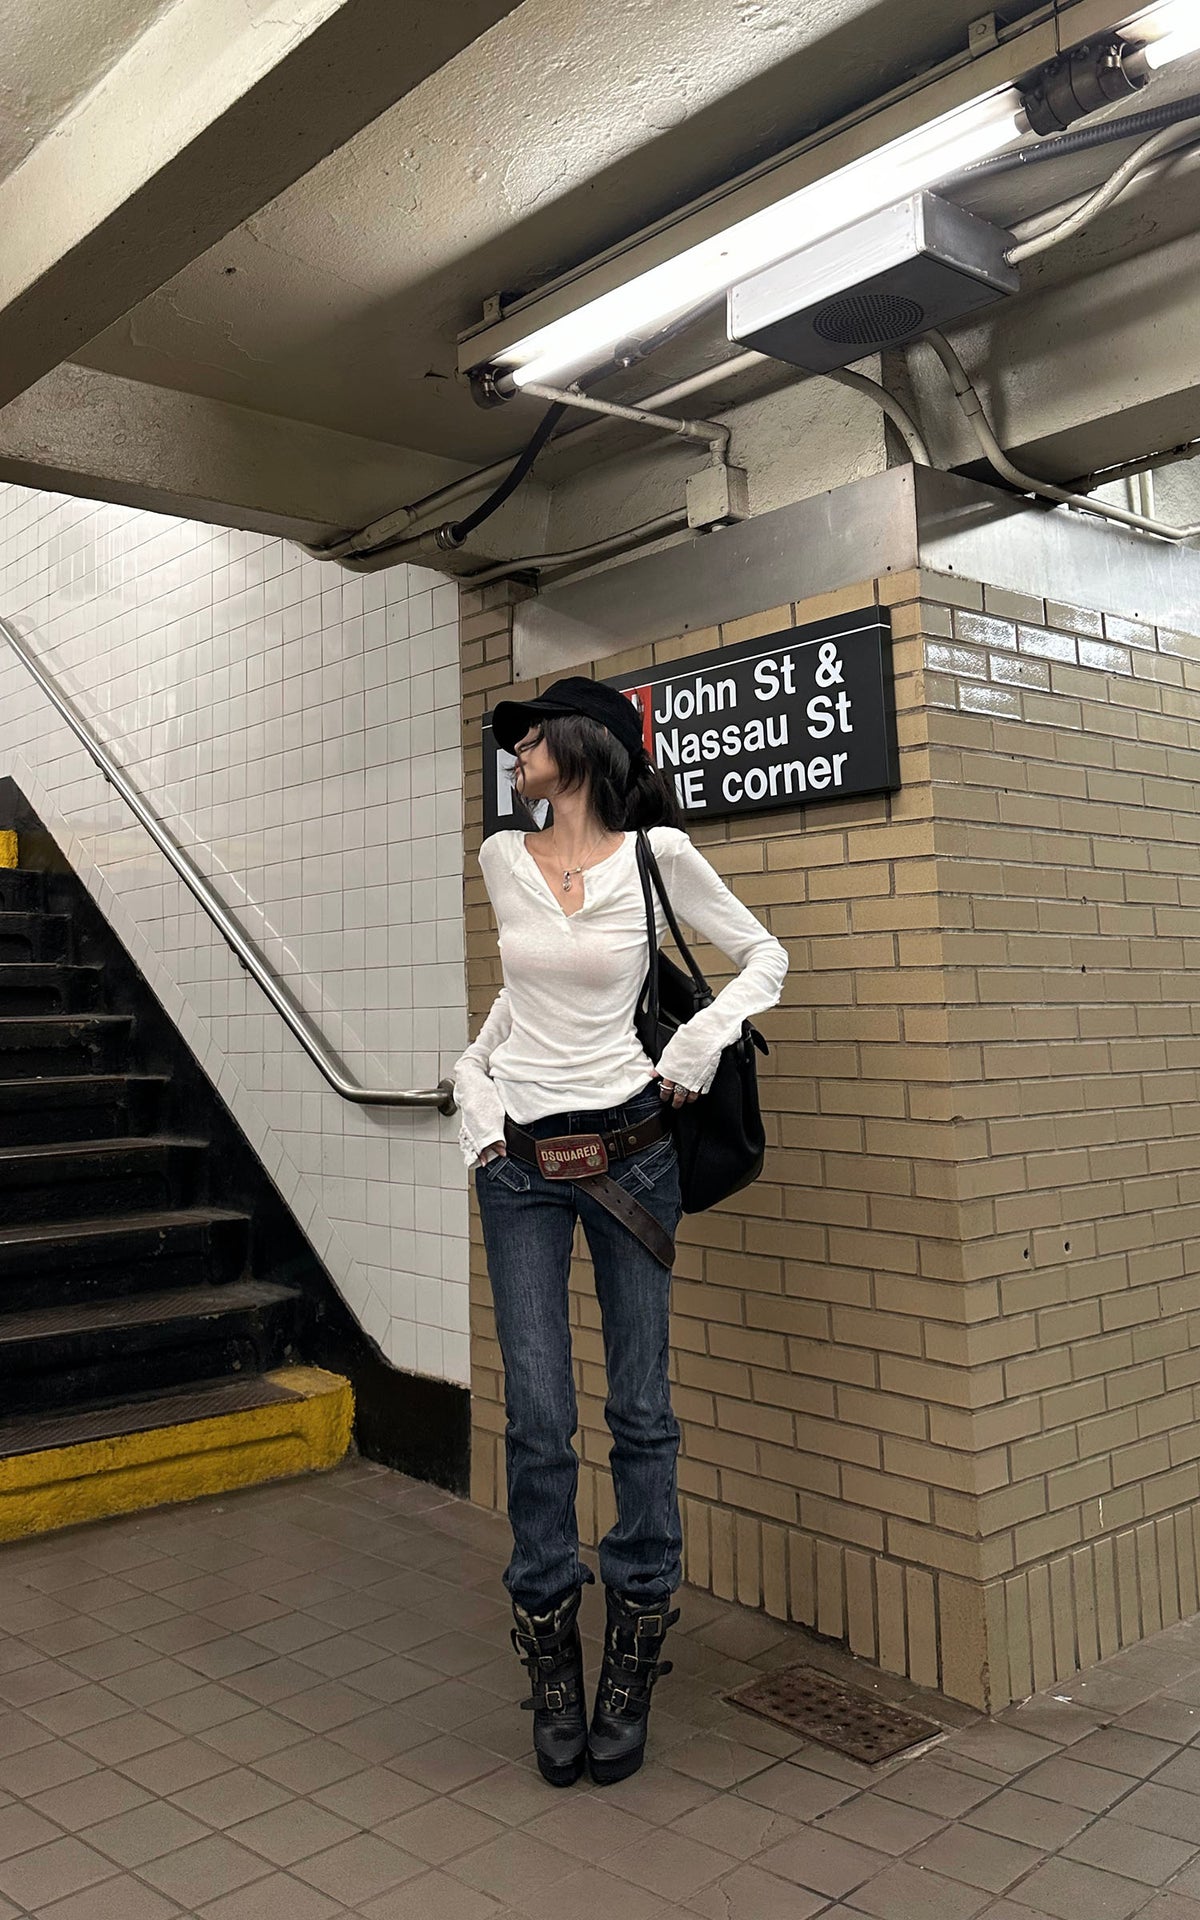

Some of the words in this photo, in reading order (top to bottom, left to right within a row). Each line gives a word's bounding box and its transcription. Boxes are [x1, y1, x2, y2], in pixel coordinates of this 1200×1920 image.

[654, 676, 737, 724] John
[753, 654, 796, 701] St
[814, 642, 845, 688] &
[655, 713, 789, 770] Nassau
[806, 690, 853, 739] St
[722, 752, 848, 803] corner
